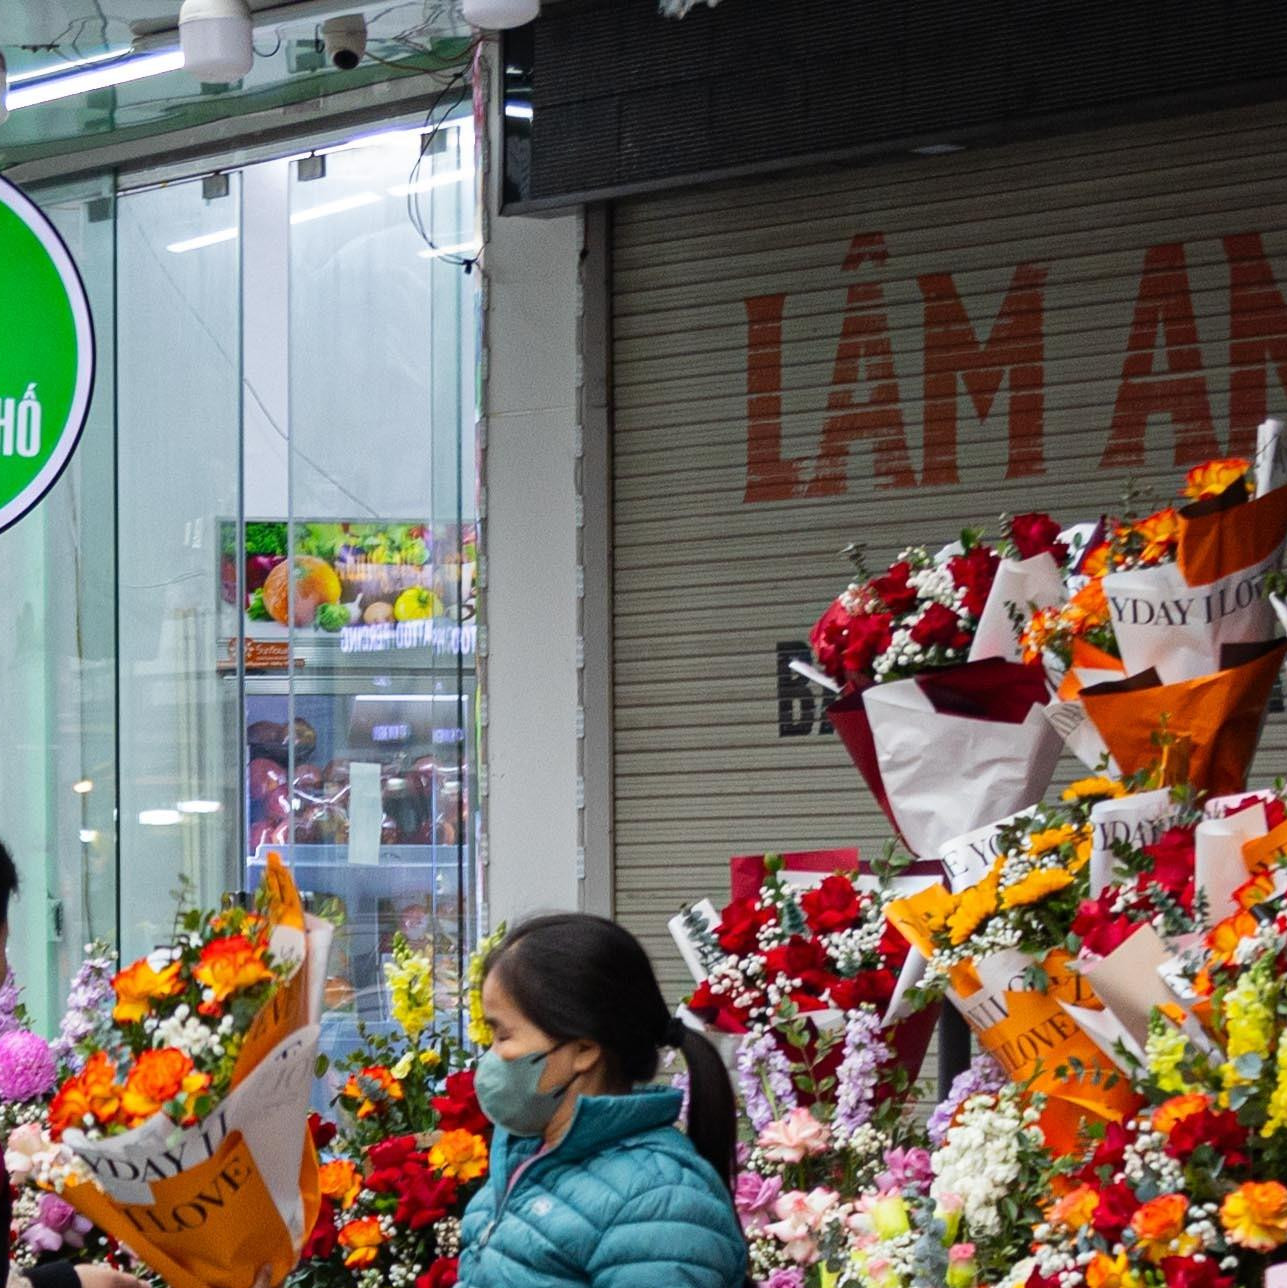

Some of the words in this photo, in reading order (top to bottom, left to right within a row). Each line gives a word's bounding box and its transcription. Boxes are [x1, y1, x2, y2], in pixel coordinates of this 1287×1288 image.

[742, 231, 1049, 504] LÂM
[80, 1140, 186, 1184] YDAY
[145, 1155, 253, 1233] LOVE
